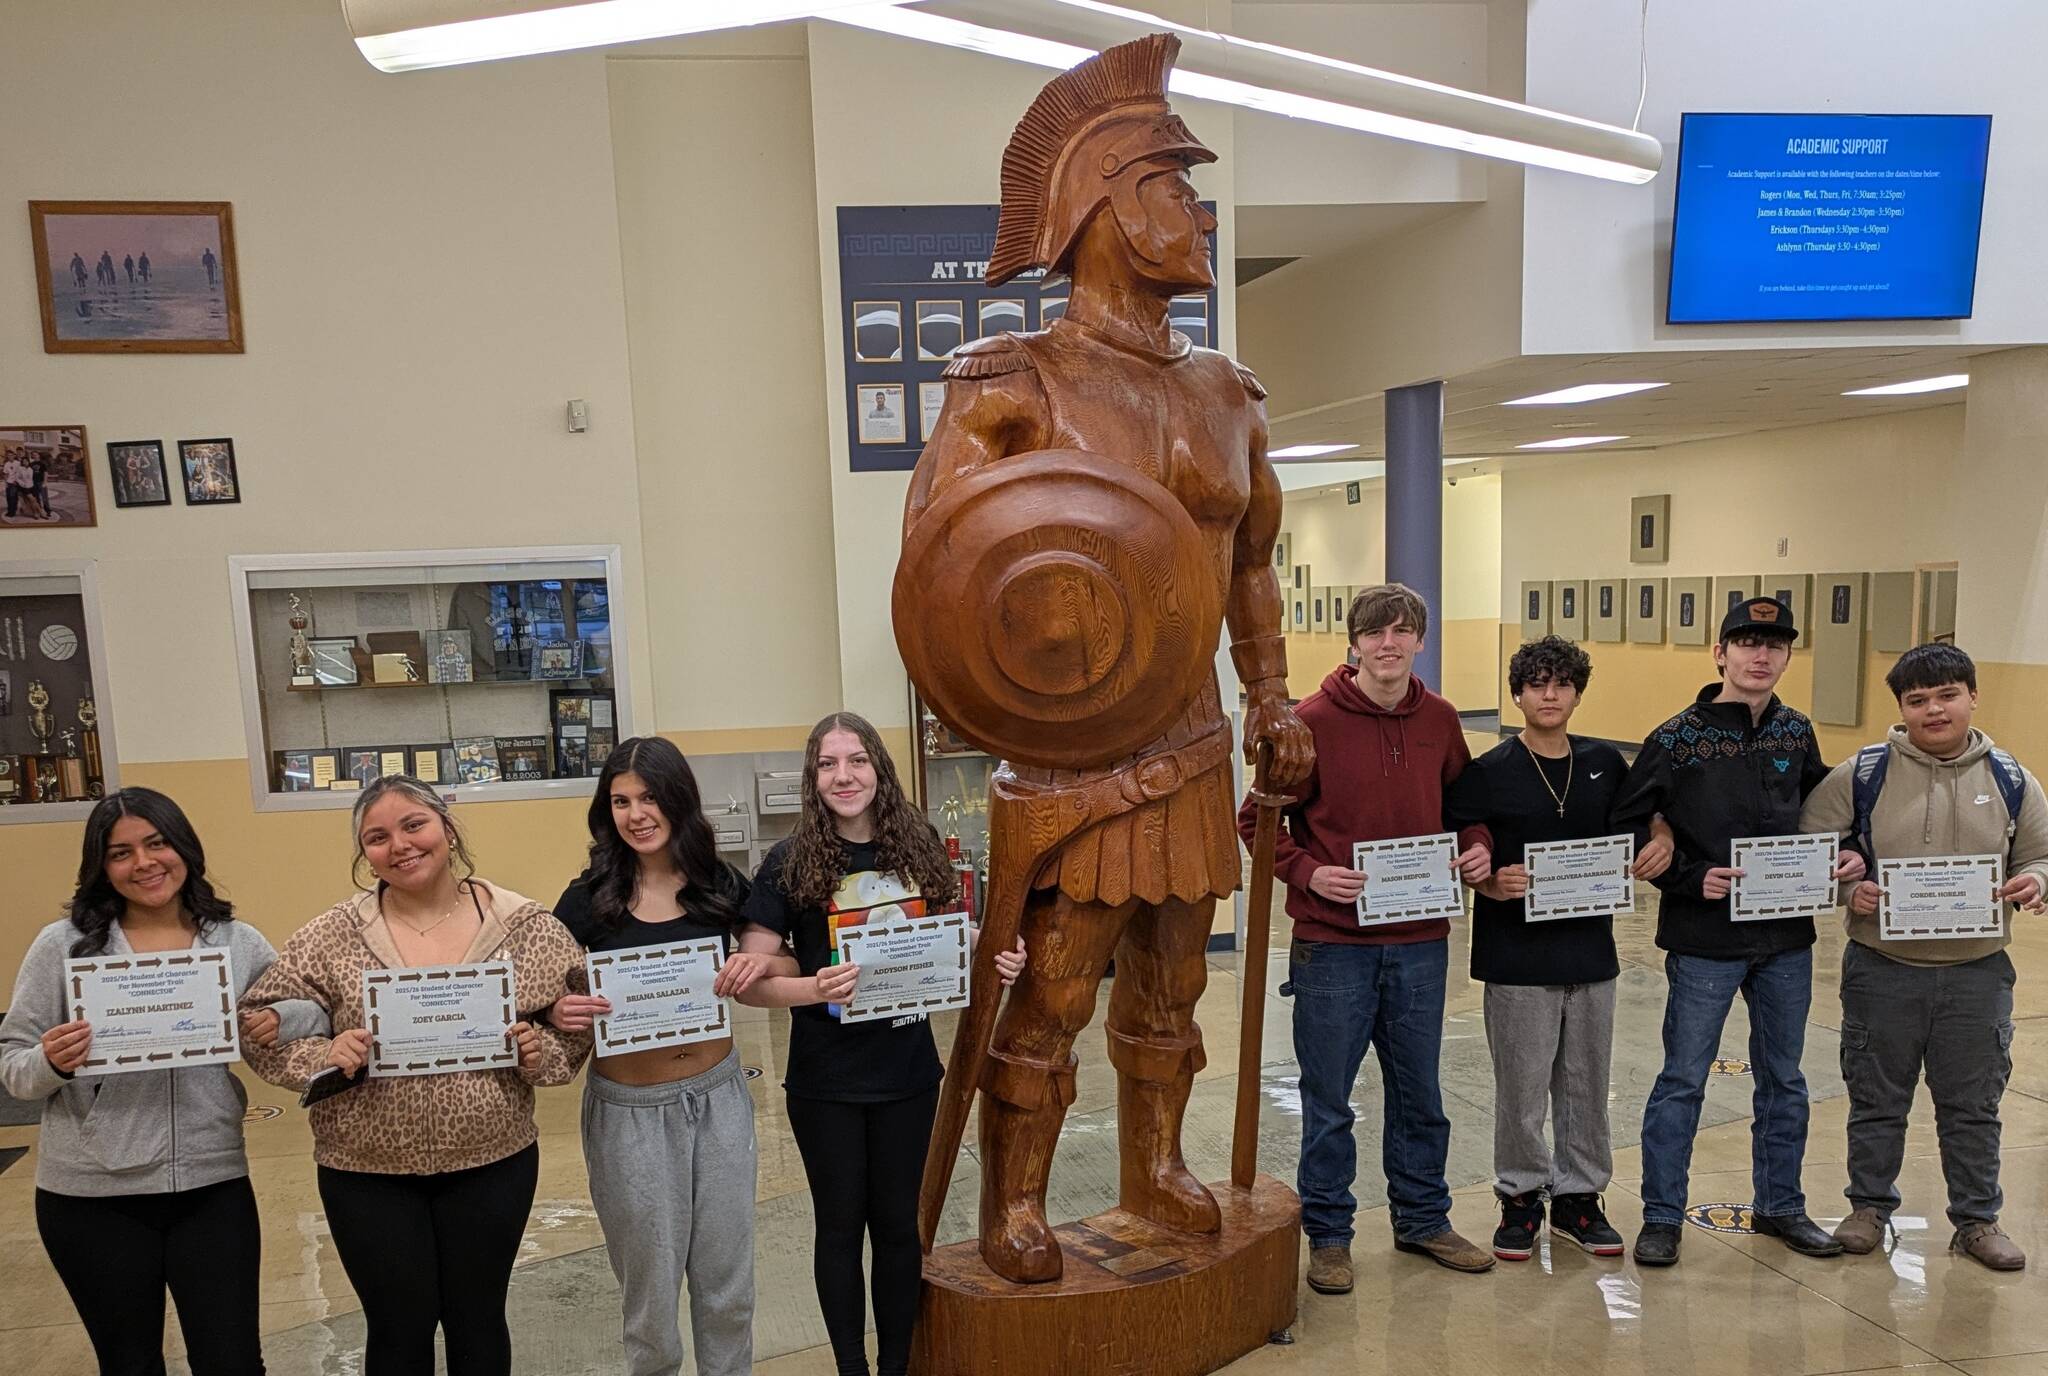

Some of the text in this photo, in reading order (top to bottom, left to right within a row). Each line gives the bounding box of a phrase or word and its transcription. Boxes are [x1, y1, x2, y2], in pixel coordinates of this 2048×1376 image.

[1786, 138, 1888, 154] ACADEMIC SUPPORT
[1760, 190, 1782, 201] Rogers
[1757, 208, 1776, 219] James
[1778, 208, 1783, 217] &
[1784, 208, 1811, 217] Brandon
[1770, 225, 1798, 234] Erickson
[1776, 242, 1802, 253] Ashlynn
[931, 262, 958, 279] AT
[888, 938, 910, 946] Student
[916, 933, 943, 942] Character
[890, 944, 916, 953] November
[640, 964, 662, 972] Student
[669, 958, 697, 967] Character
[873, 961, 934, 976] ADDYSON FISHER
[129, 972, 155, 981] Student
[166, 969, 199, 978] Character
[631, 972, 641, 980] For
[642, 970, 670, 978] November
[132, 980, 166, 989] November
[166, 978, 184, 986] Trait
[420, 984, 445, 992] Student
[128, 987, 176, 997] "CONNECTOR"
[422, 992, 453, 1000] November
[626, 987, 690, 1003] BRIANA SALAZAR
[418, 998, 462, 1007] "CONNECTOR"
[106, 1002, 194, 1017] IZALYNN MARTINEZ
[412, 1012, 466, 1024] ZOEY GARCIA
[892, 1014, 917, 1028] SOUTH
